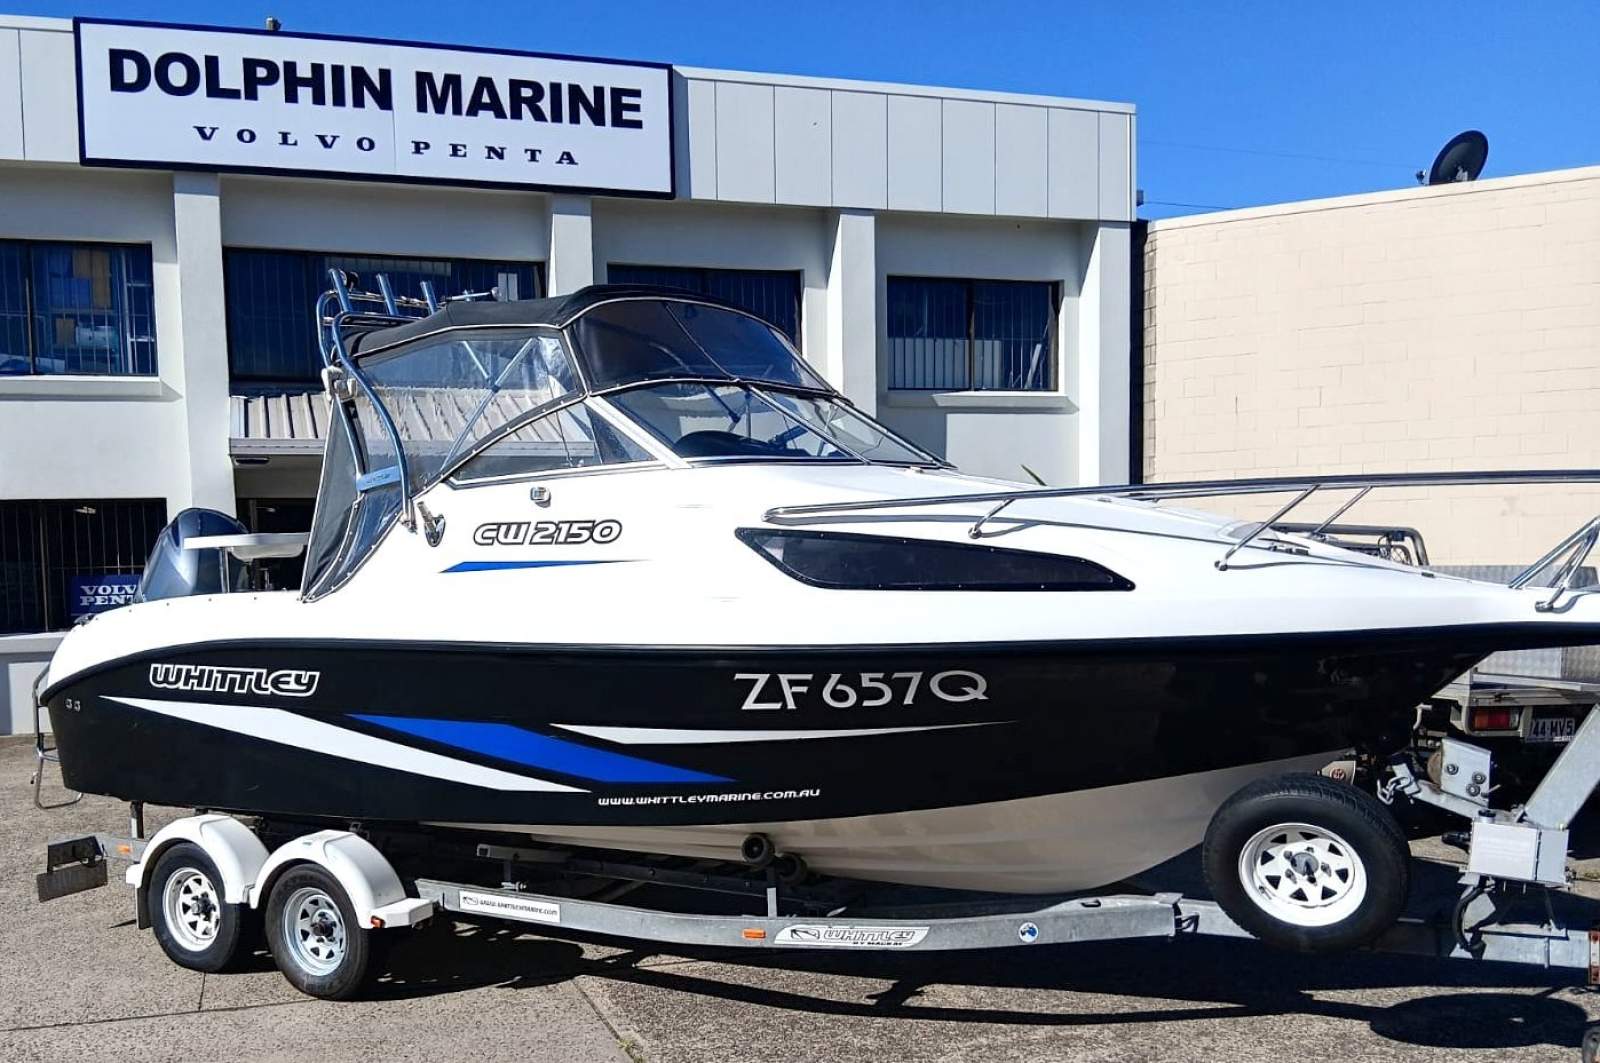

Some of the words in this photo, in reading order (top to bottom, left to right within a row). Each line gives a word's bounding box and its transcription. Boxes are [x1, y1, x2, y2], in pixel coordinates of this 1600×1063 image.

[108, 47, 393, 112] DOLPHIN
[415, 70, 643, 130] MARINE
[193, 125, 376, 152] VOLVO
[411, 140, 579, 166] PENTA
[473, 521, 531, 546] CW
[529, 519, 623, 545] 2150
[79, 594, 134, 606] PENT
[80, 585, 136, 595] VOLV
[149, 663, 320, 697] WHITTLEY
[734, 673, 814, 710] ZF
[822, 670, 990, 709] 657Q
